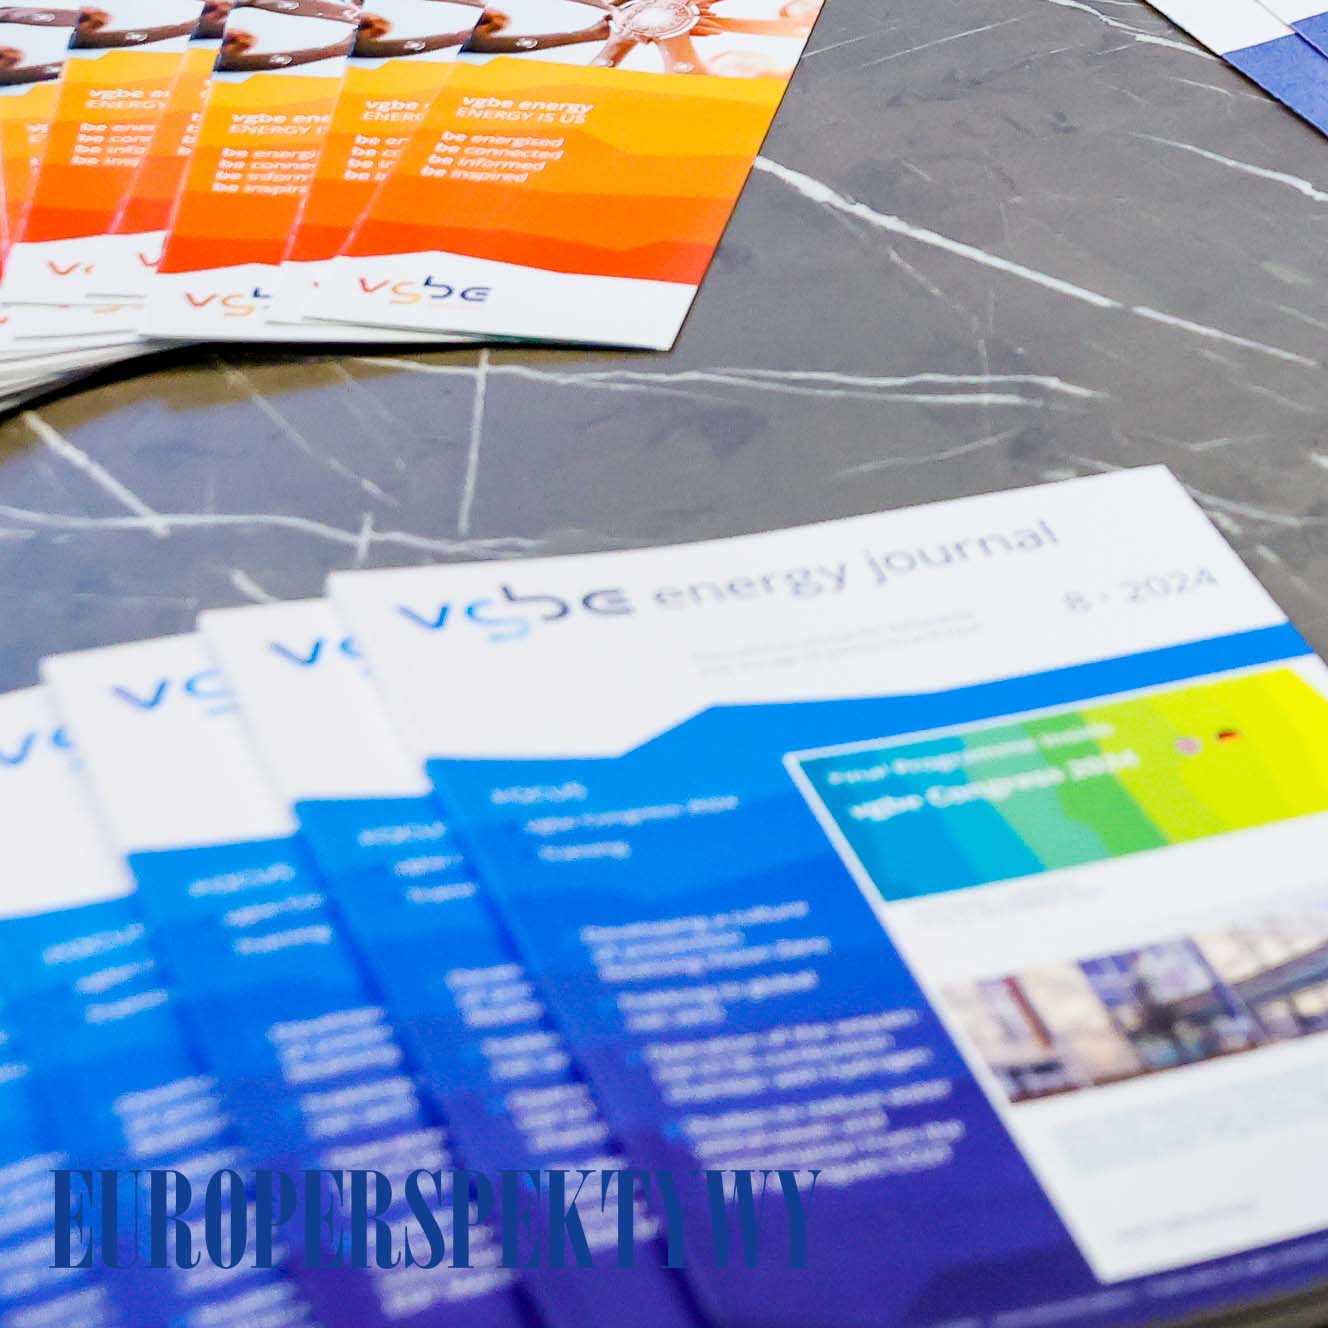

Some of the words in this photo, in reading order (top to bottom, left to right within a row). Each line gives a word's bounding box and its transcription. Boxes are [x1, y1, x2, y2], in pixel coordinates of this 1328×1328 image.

[463, 96, 514, 109] vgbe
[519, 100, 593, 115] energy
[456, 107, 532, 121] ENERGY
[538, 112, 553, 122] IS
[560, 114, 586, 124] US
[441, 130, 467, 142] be
[435, 142, 461, 154] be
[463, 146, 564, 160] connected
[428, 153, 454, 165] be
[457, 157, 546, 171] informed
[420, 165, 447, 177] be
[450, 169, 529, 183] inspired
[359, 275, 493, 304] vgbe
[397, 583, 636, 642] vgbe
[653, 556, 848, 612] energy
[862, 520, 1062, 587] journal
[1062, 586, 1092, 616] 8
[1117, 565, 1219, 608] 2024
[850, 793, 924, 821] vgbe
[925, 766, 1066, 808] Congress
